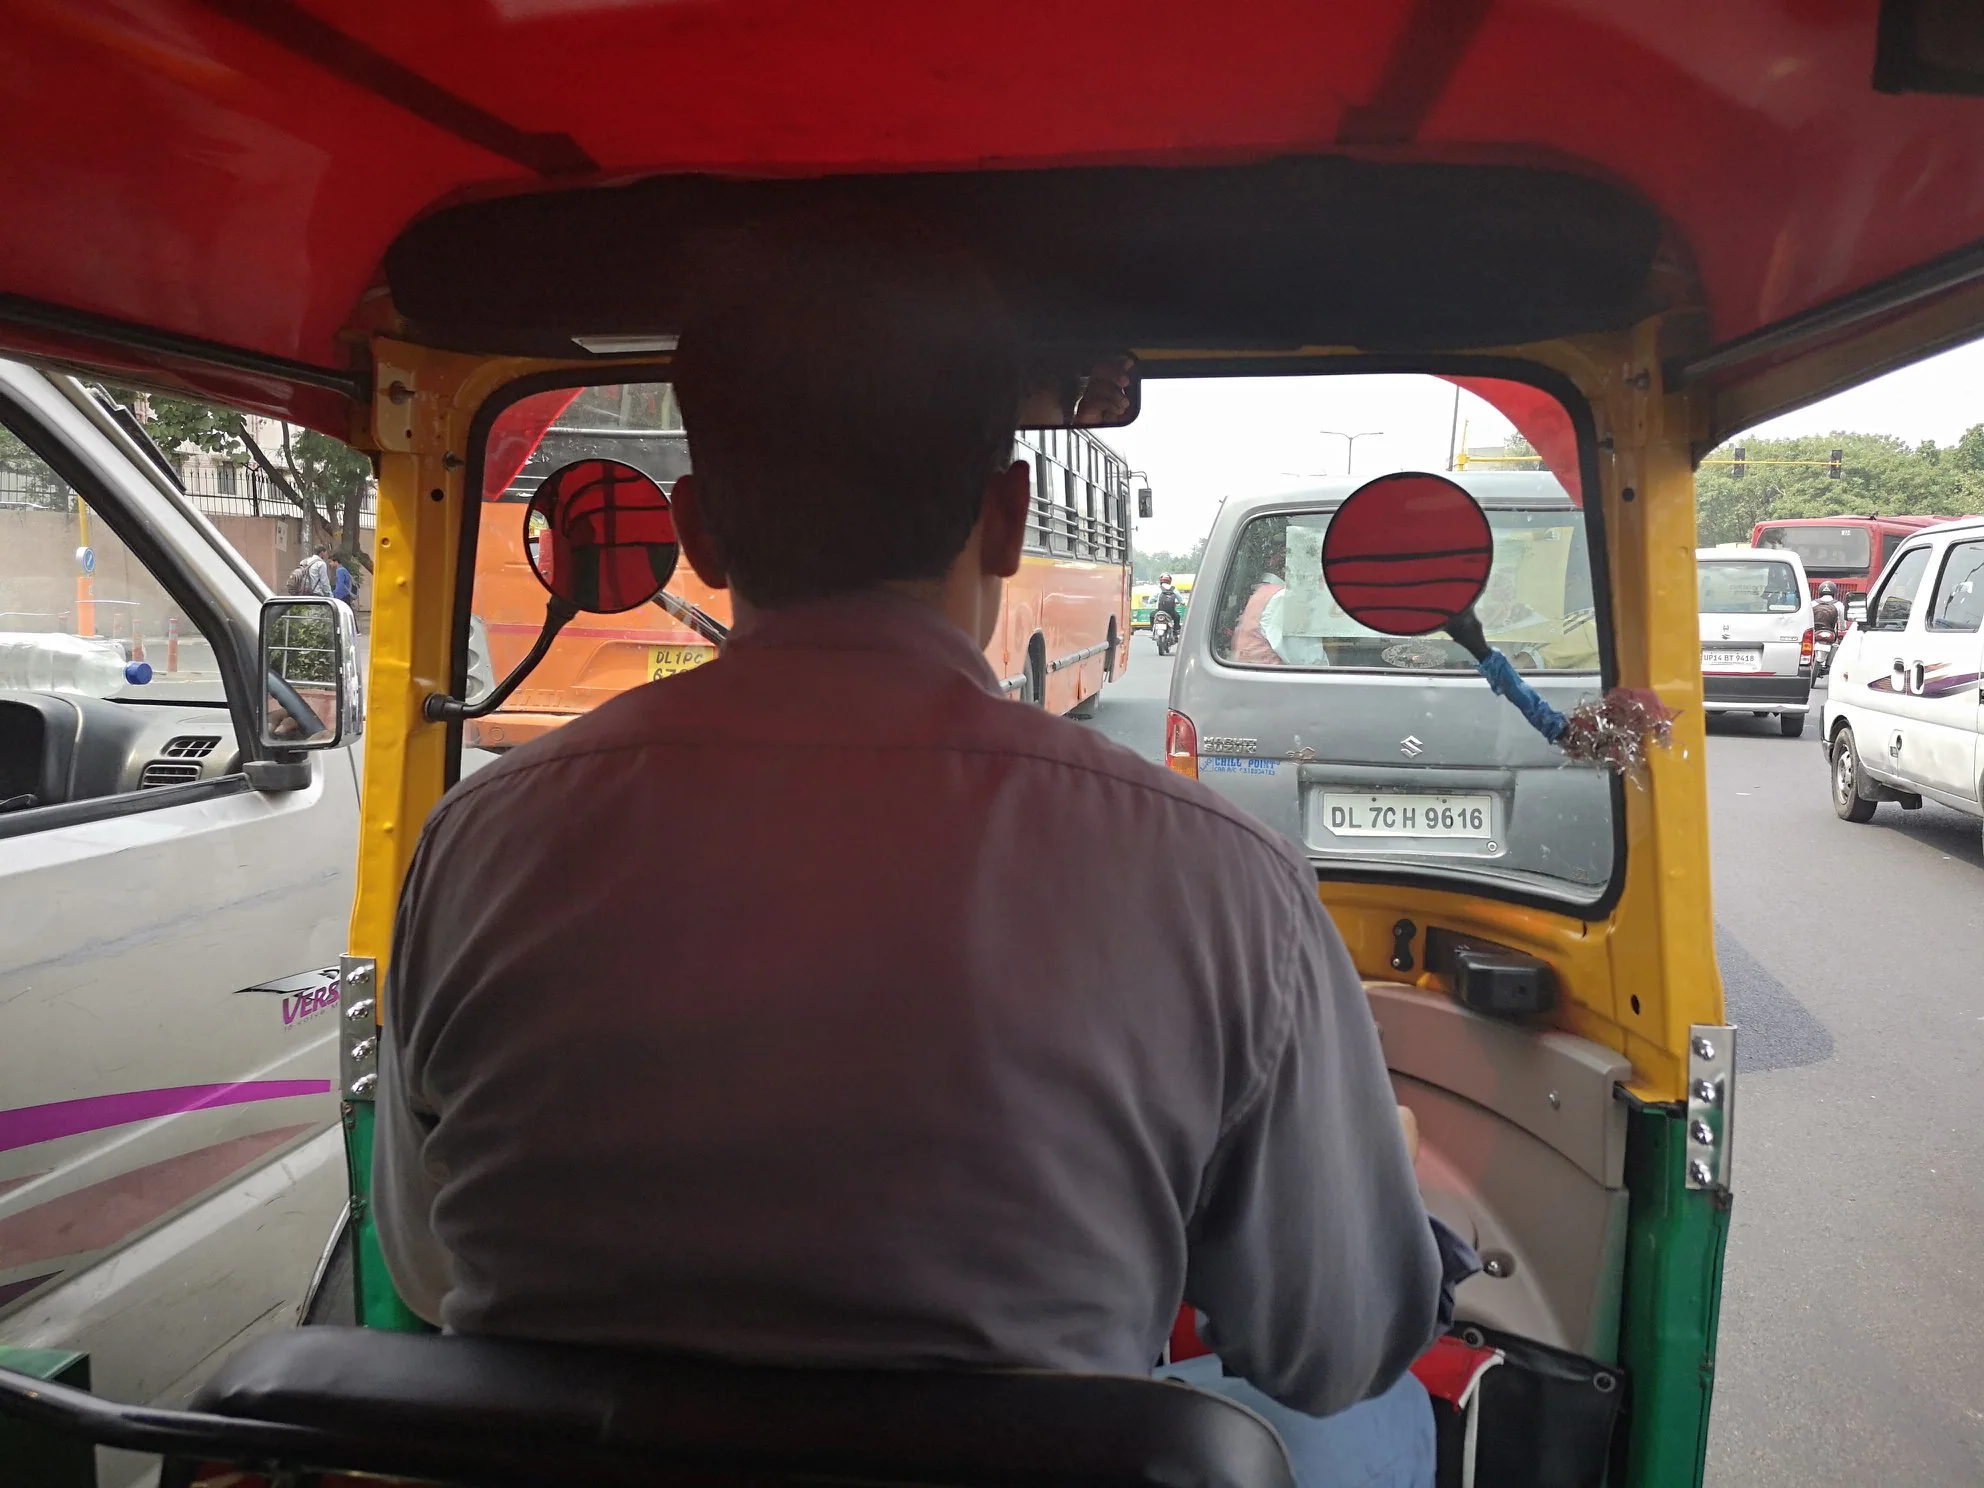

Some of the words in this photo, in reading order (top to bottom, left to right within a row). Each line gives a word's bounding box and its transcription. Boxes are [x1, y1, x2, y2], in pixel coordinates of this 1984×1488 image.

[1214, 757, 1242, 768] CHILL
[1248, 758, 1275, 770] POINT
[1331, 806, 1362, 828] DL
[1425, 807, 1483, 830] 9616
